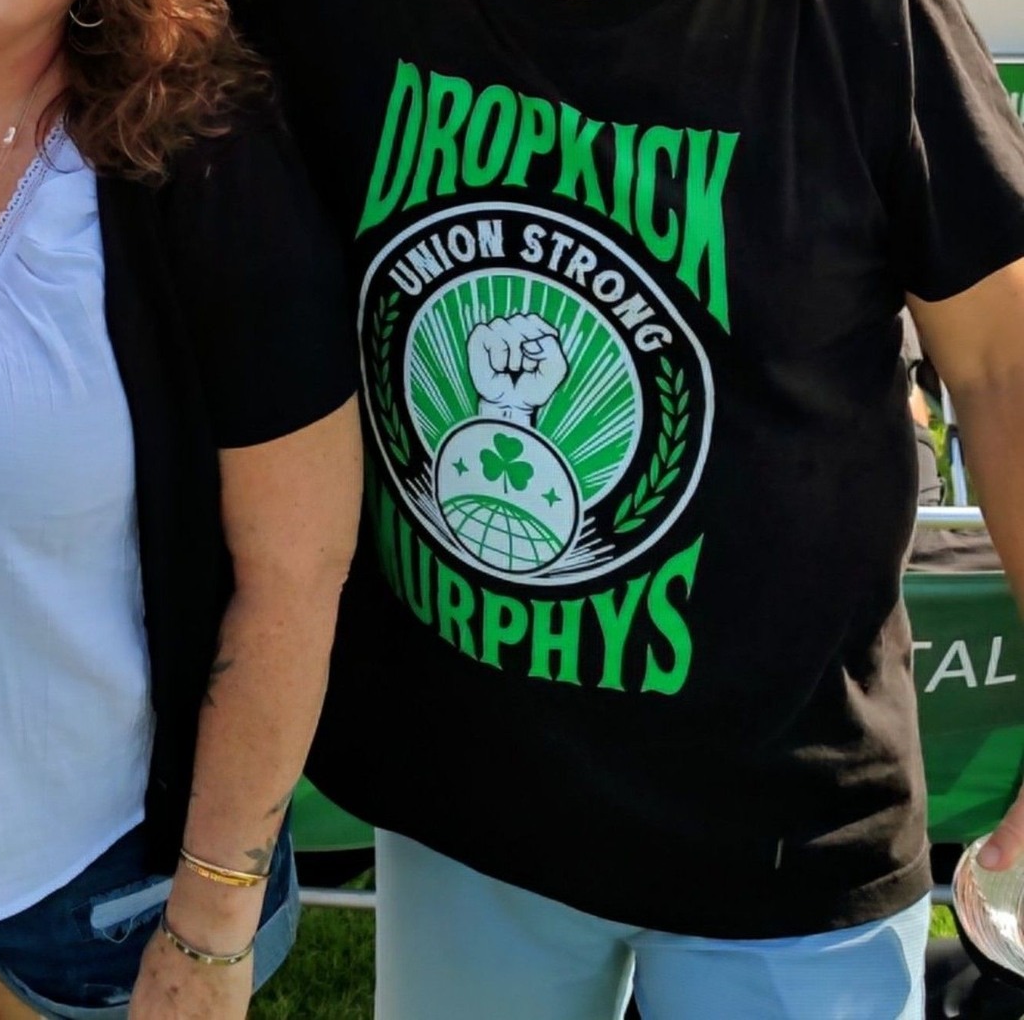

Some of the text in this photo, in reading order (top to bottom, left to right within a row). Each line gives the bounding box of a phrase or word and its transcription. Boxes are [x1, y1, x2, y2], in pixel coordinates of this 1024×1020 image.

[355, 58, 740, 335] DROPKICK
[388, 219, 673, 352] UNION STRONG
